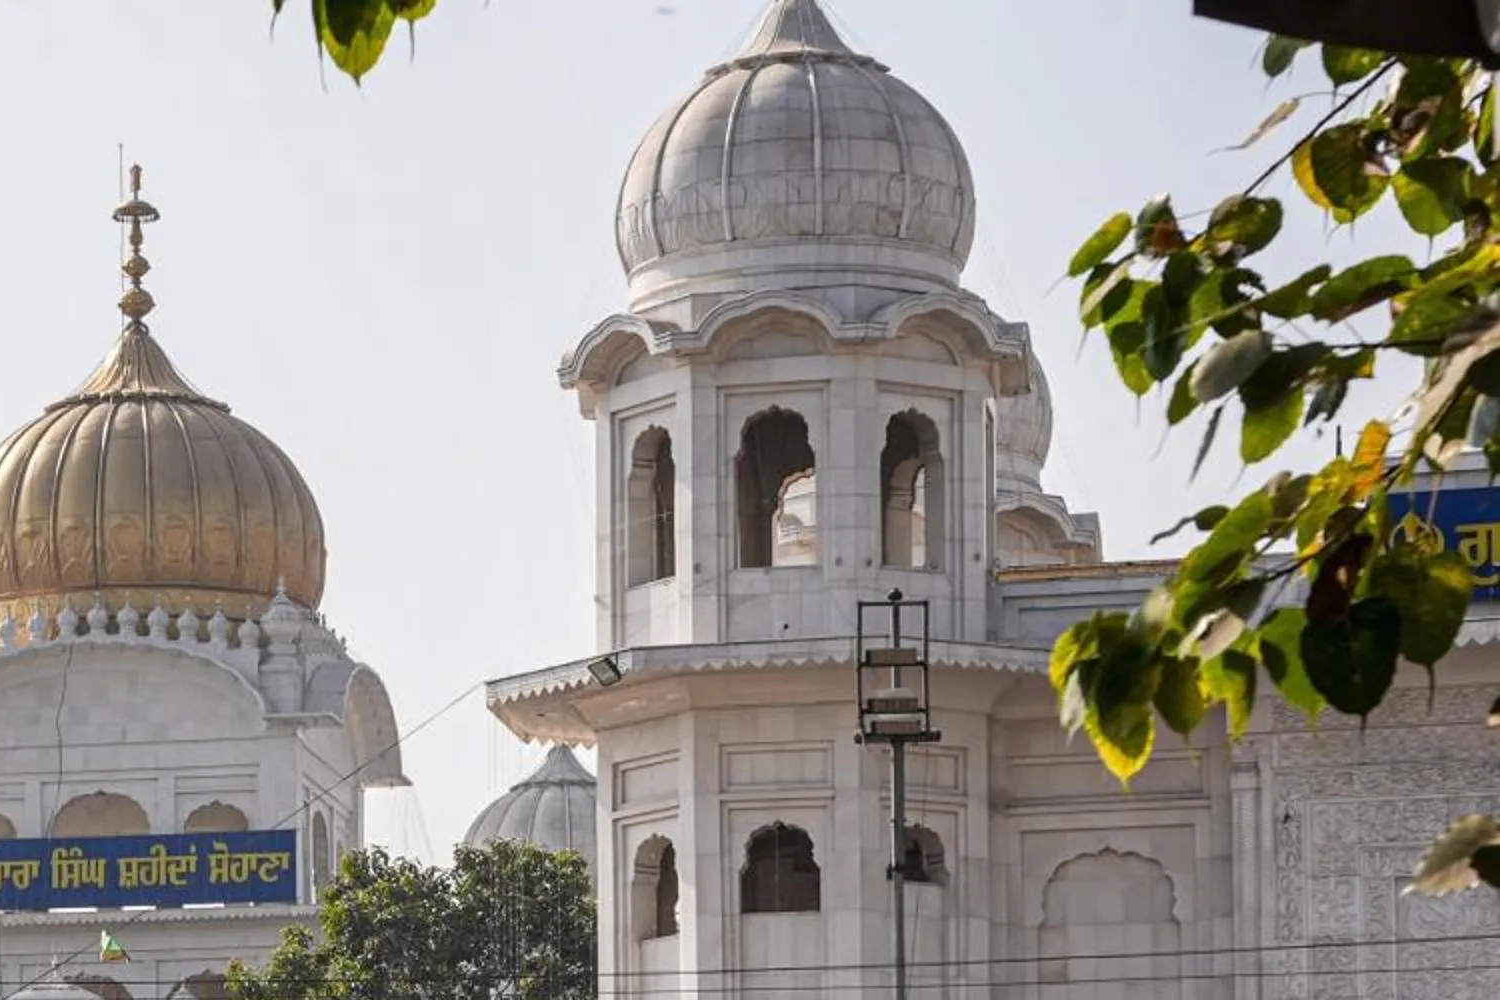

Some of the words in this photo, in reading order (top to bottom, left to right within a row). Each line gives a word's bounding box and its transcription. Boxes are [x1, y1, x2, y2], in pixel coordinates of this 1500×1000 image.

[51, 846, 107, 889] ਸਿੰਘ
[117, 844, 197, 887] ਸ਼ਹੀਦਾਂ
[207, 841, 291, 884] ਸੋਹਾਣਾ
